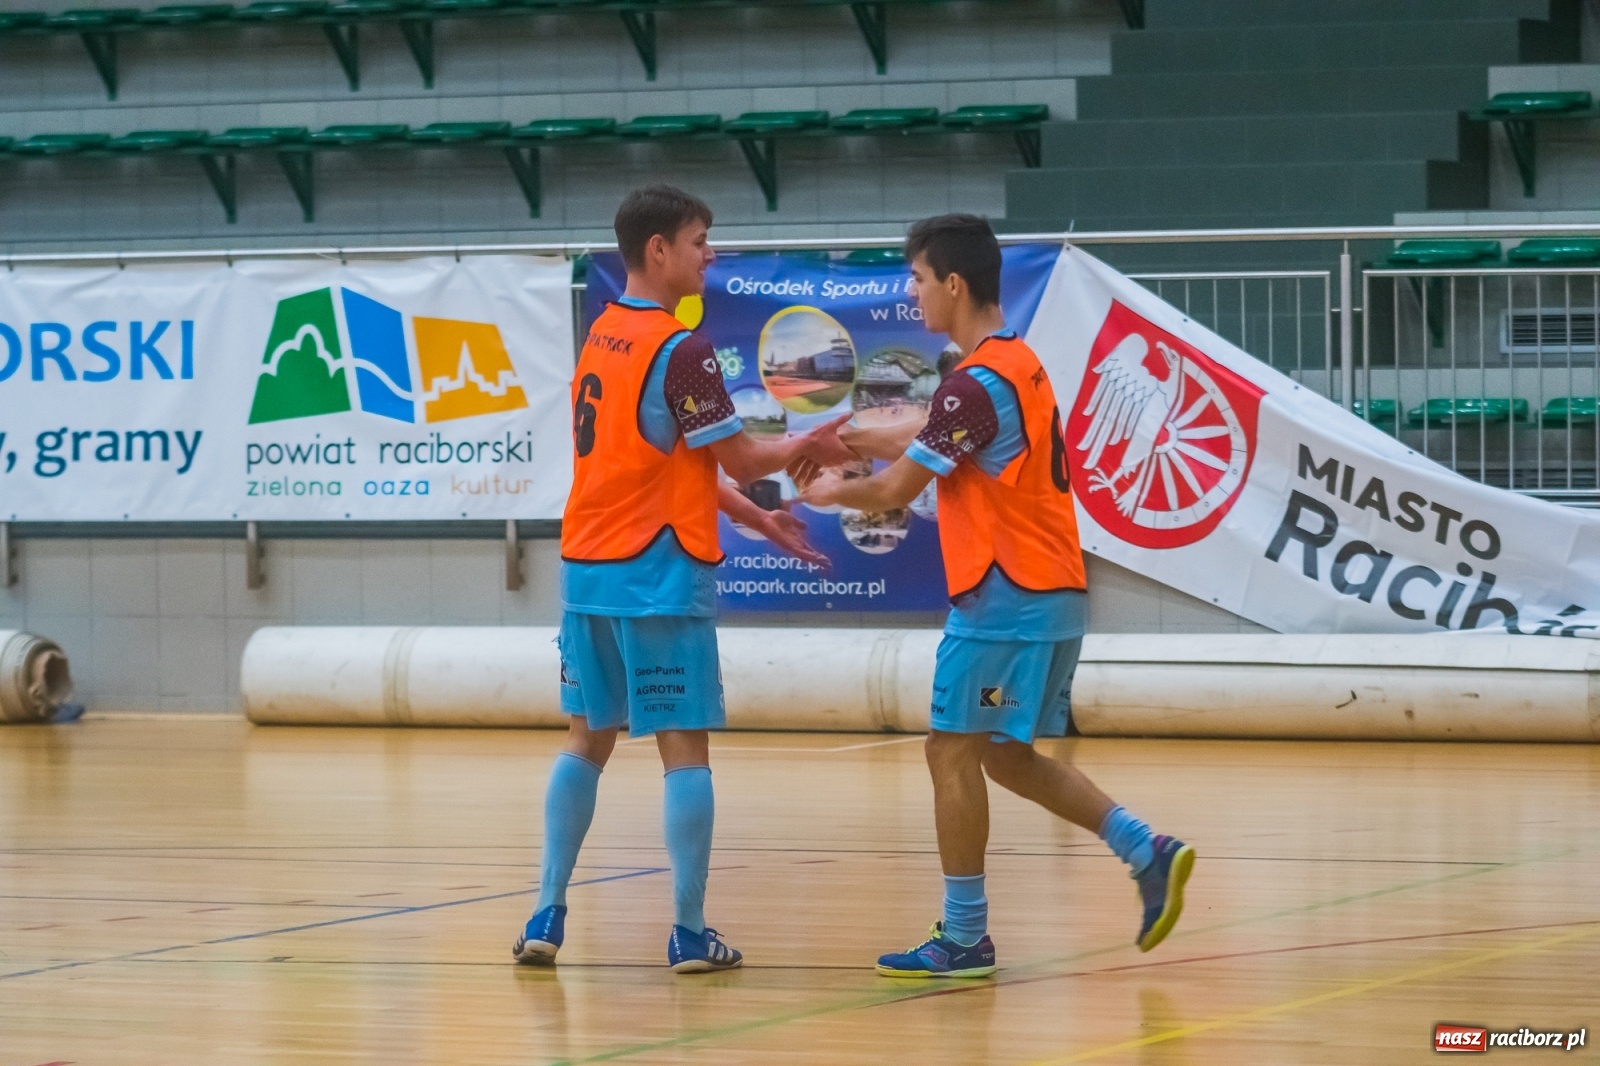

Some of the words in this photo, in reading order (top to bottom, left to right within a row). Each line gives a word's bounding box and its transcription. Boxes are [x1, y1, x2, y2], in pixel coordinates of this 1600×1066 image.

[726, 277, 816, 296] Ośrodek
[820, 279, 888, 300] Sportu
[892, 279, 899, 294] i
[870, 307, 889, 321] w
[574, 373, 603, 458] 6
[34, 426, 204, 478] gramy
[246, 433, 357, 475] powiat
[379, 430, 533, 465] raciborski
[246, 476, 342, 497] zielona
[363, 480, 430, 496] oaza
[450, 475, 533, 496] kultur
[1297, 443, 1502, 560] MIASTO
[635, 666, 685, 677] Geo-Punkt
[636, 685, 686, 697] AGROTIM
[643, 703, 677, 714] KIETRZ
